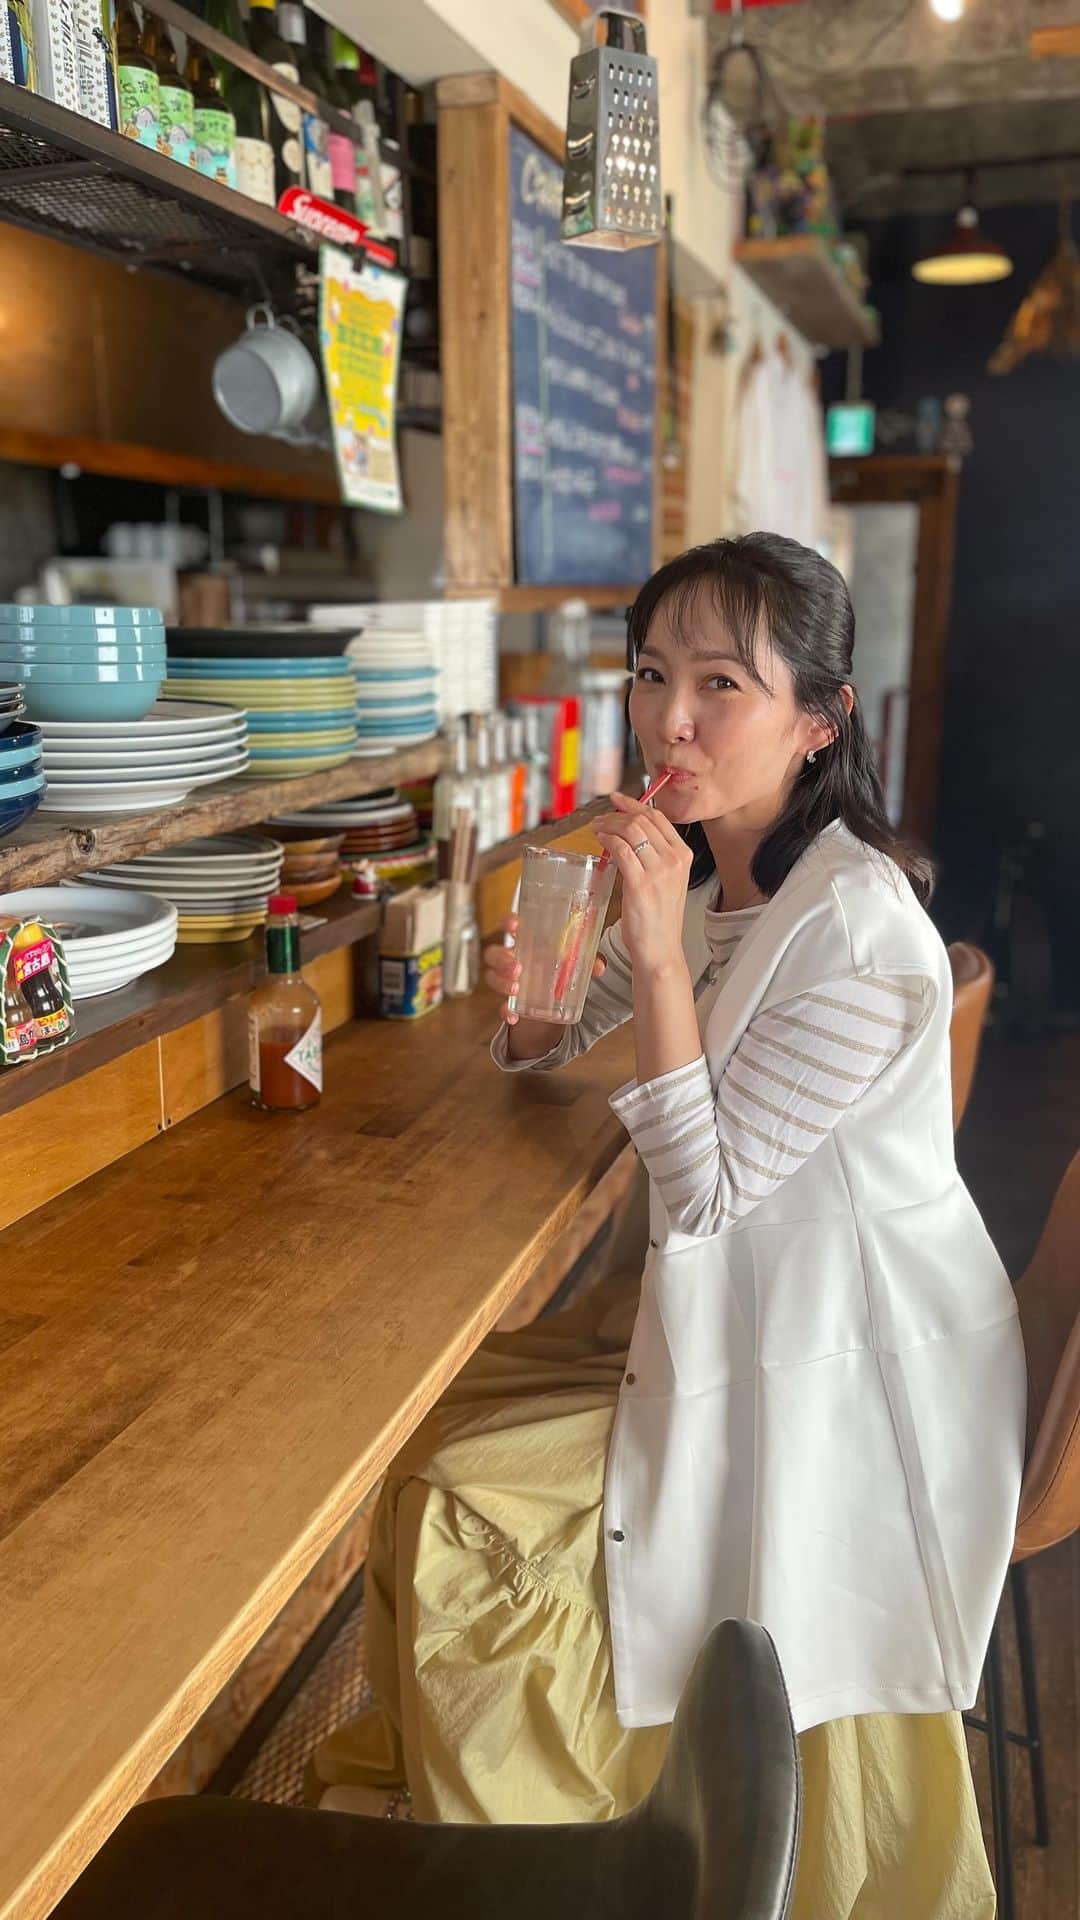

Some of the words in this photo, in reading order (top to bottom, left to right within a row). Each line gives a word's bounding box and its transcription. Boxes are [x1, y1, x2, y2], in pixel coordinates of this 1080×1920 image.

[287, 194, 360, 244] Supreme
[23, 952, 51, 977] 宮古島
